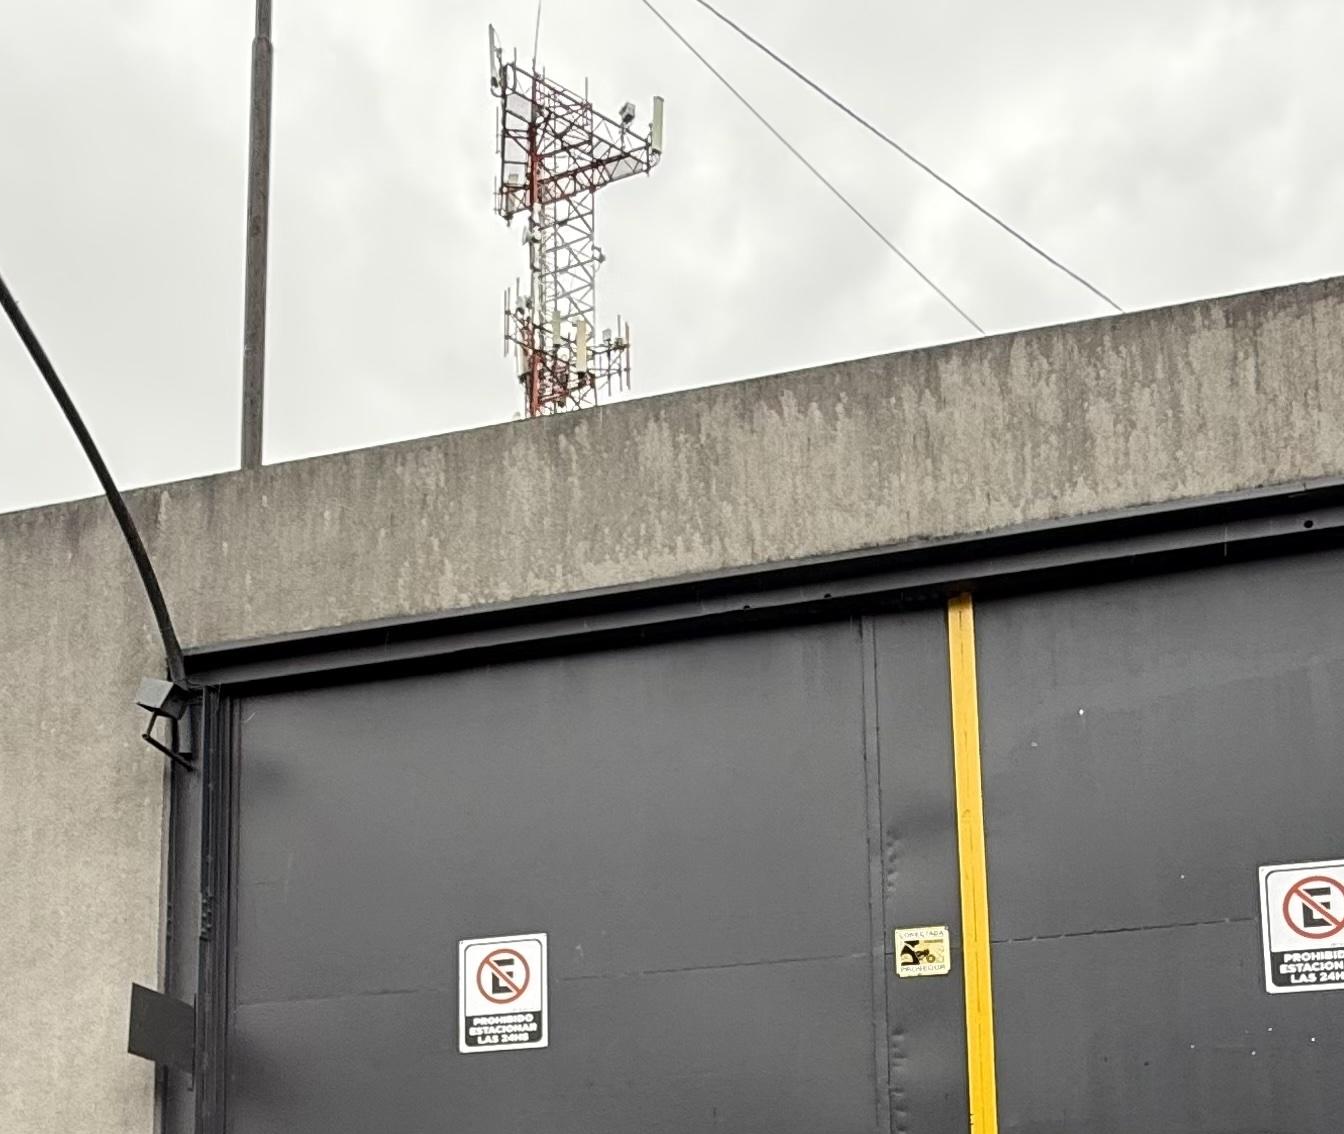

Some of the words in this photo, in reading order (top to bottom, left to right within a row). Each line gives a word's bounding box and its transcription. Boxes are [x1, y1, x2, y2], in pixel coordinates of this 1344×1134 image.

[1290, 973, 1317, 984] LAS
[473, 1013, 534, 1026] PROHIBIDO
[469, 1022, 537, 1036] ESTACIONAR
[477, 1035, 499, 1045] LAS
[501, 1032, 529, 1043] 24HS
